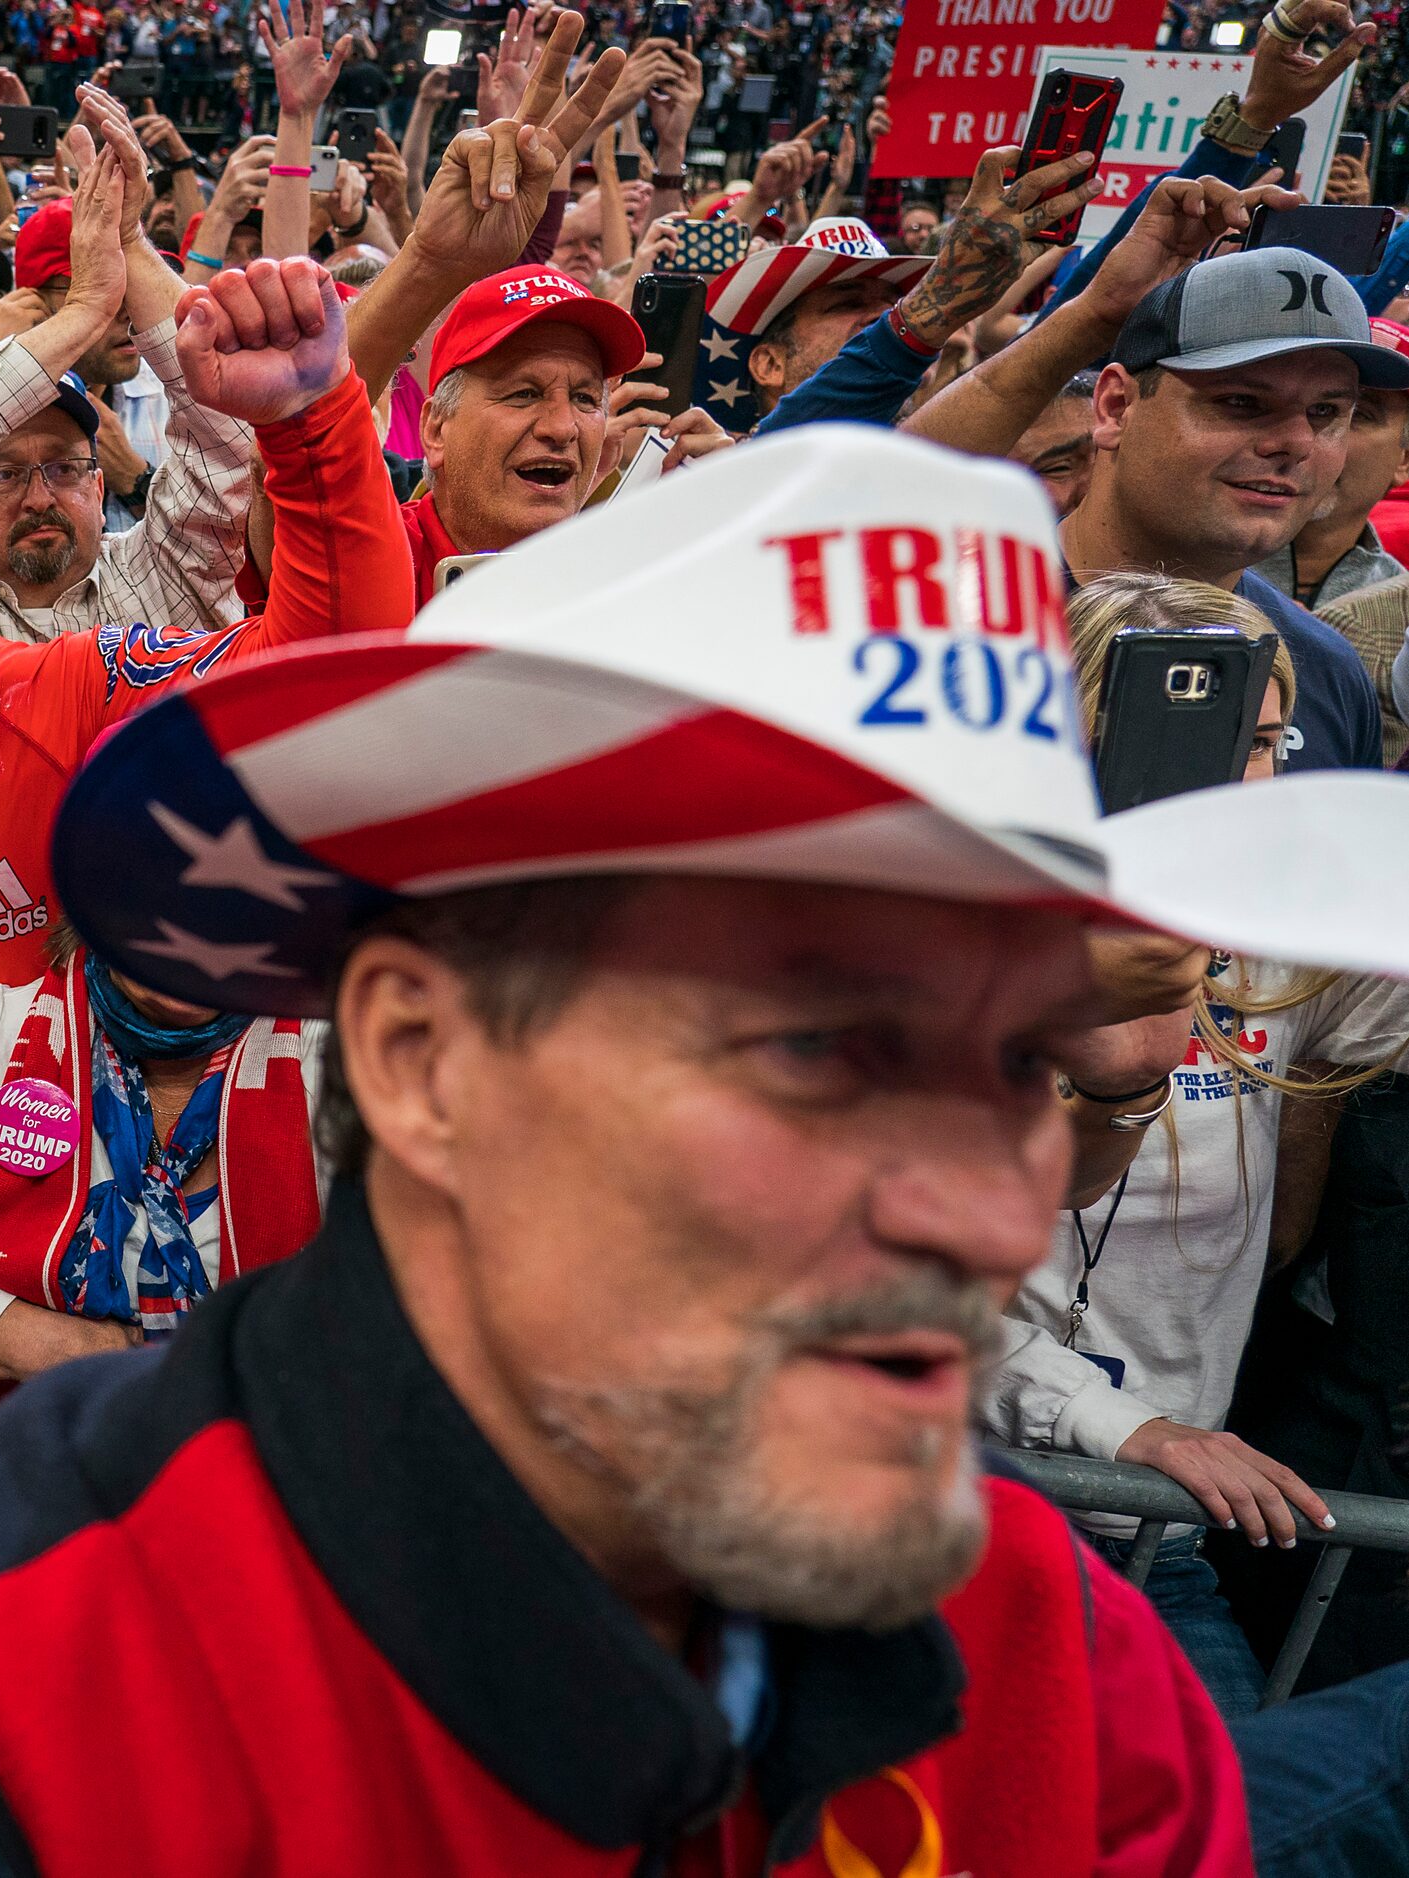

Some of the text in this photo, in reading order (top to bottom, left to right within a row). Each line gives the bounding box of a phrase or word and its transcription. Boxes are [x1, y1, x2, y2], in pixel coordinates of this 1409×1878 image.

[935, 0, 1117, 26] THANK YOU
[529, 293, 569, 306] 20
[849, 632, 1068, 743] 202
[1173, 1072, 1202, 1087] THE
[1183, 1087, 1201, 1101] IN
[1200, 1084, 1236, 1101] THE
[0, 1085, 72, 1122] Women
[21, 1114, 42, 1129] for
